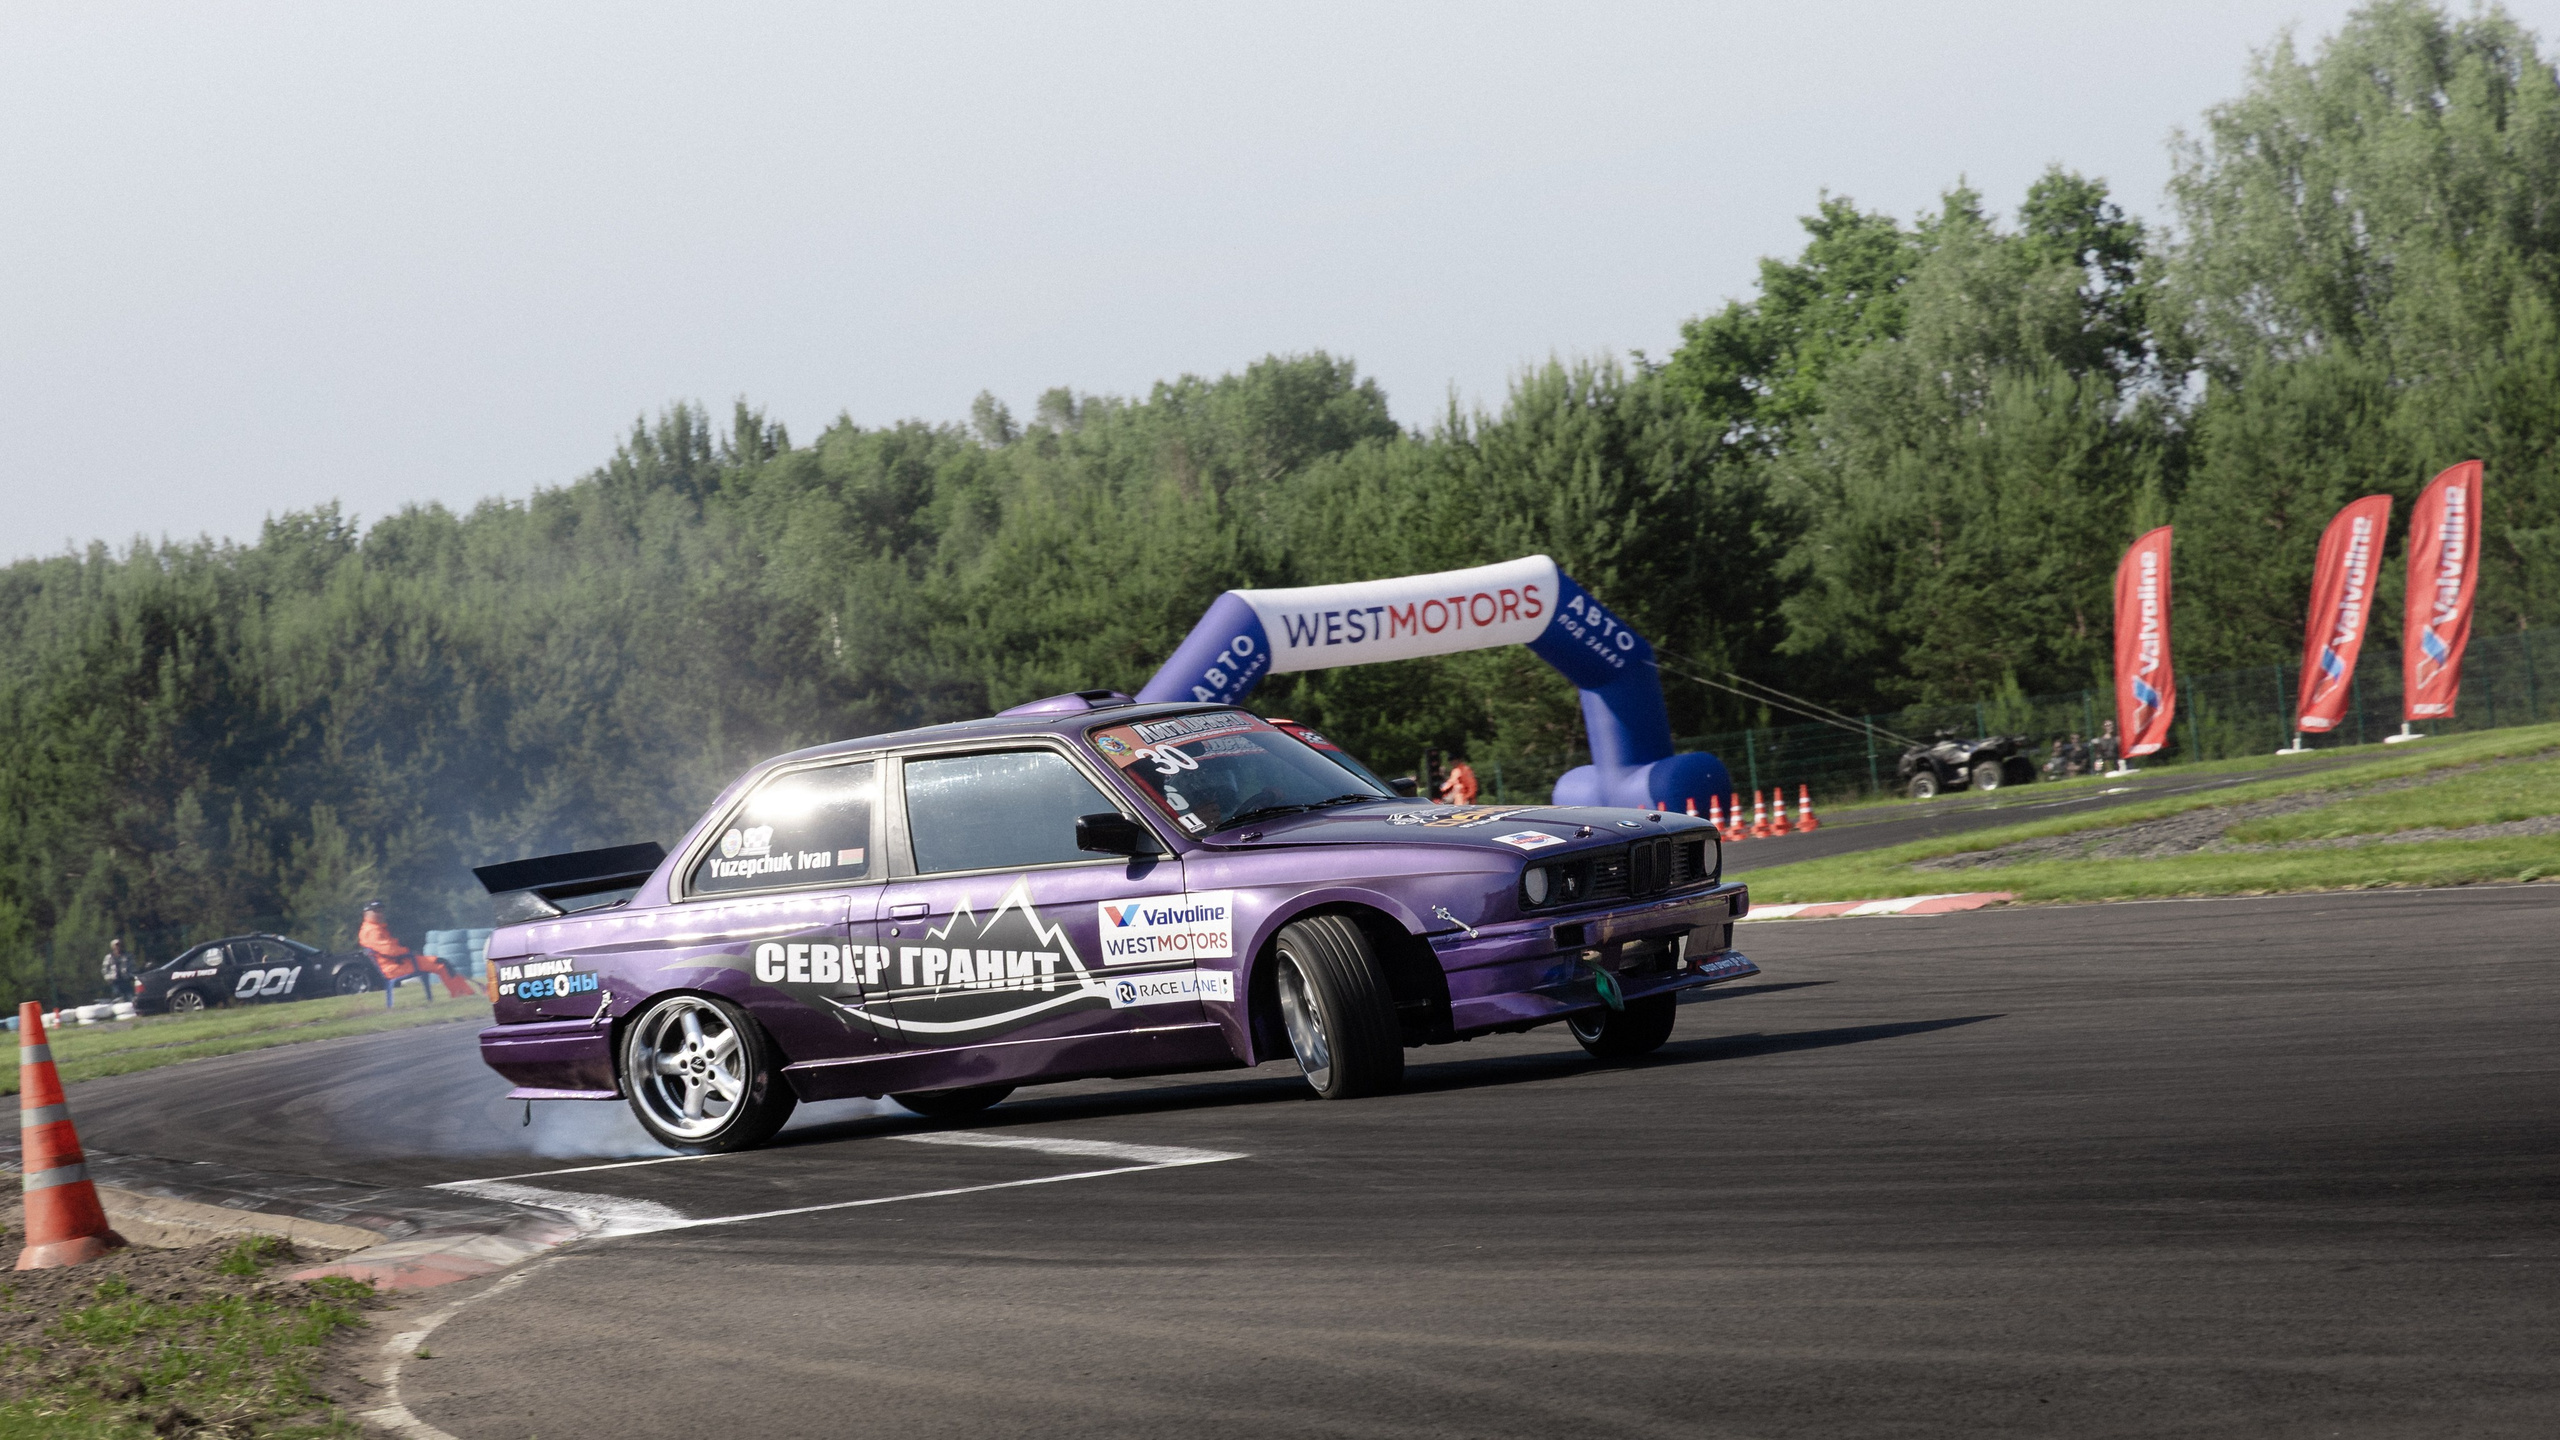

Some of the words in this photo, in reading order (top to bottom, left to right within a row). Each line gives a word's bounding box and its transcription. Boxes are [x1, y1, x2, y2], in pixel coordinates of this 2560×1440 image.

[2433, 486, 2467, 626] Valvoline
[2333, 516, 2372, 645] Valvoline
[1282, 584, 1543, 648] WESTMOTORS
[1567, 595, 1635, 651] АВТО
[2137, 551, 2161, 676] Valvoline
[1192, 635, 1255, 702] АВТО
[1134, 744, 1199, 775] 30
[709, 854, 794, 879] Yuzepchuk
[798, 851, 832, 870] Ivan
[1143, 905, 1225, 926] Valvoline
[1106, 932, 1228, 956] WESTMOTORS
[235, 966, 302, 999] 001
[500, 965, 523, 982] НА
[523, 958, 574, 979] ШИНАХ
[755, 943, 891, 985] СЕВЕР
[900, 947, 1061, 992] ГРАНИТ
[1140, 981, 1179, 997] RACE
[1181, 979, 1218, 993] LANE
